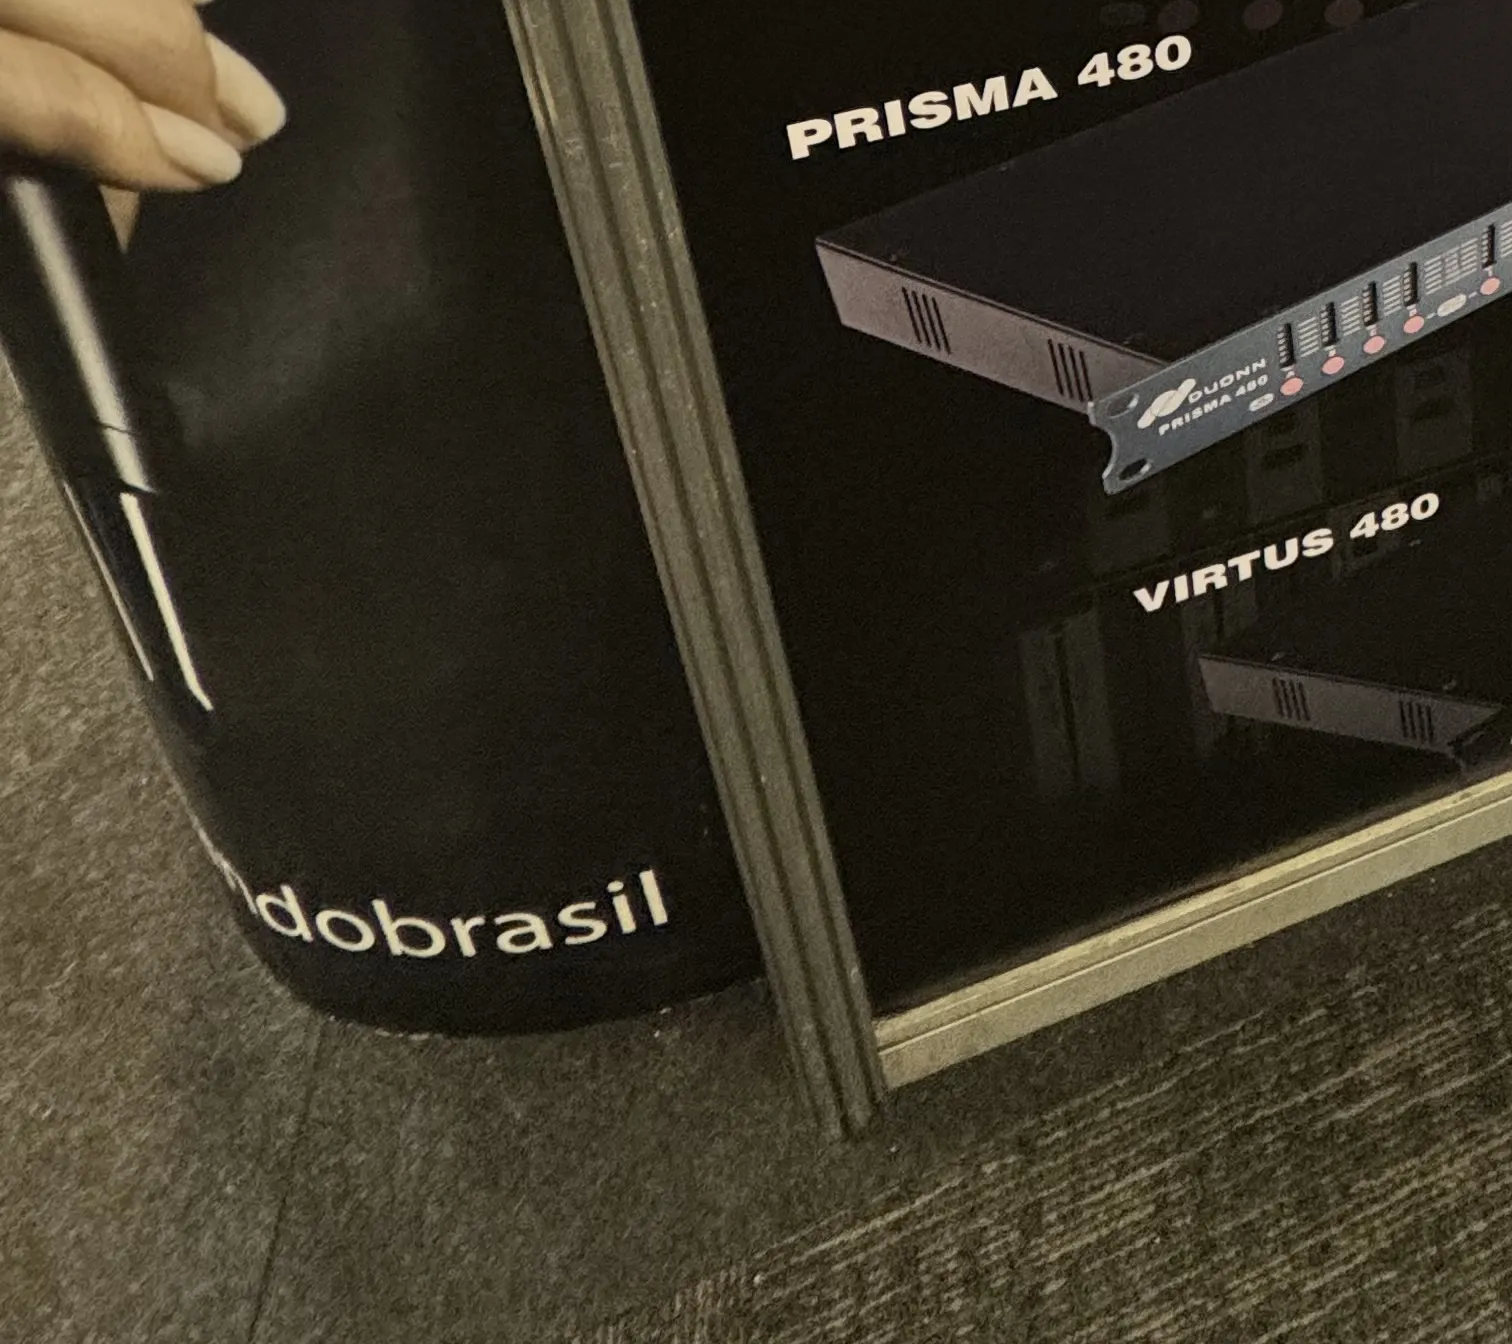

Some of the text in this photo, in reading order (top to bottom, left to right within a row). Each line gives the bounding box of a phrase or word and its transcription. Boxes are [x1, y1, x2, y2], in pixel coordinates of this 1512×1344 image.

[786, 34, 1192, 160] PRISMA 480
[1158, 374, 1268, 436] PRISMA 480
[1188, 358, 1267, 405] DUONN
[1133, 492, 1440, 612] VIRTUS 480
